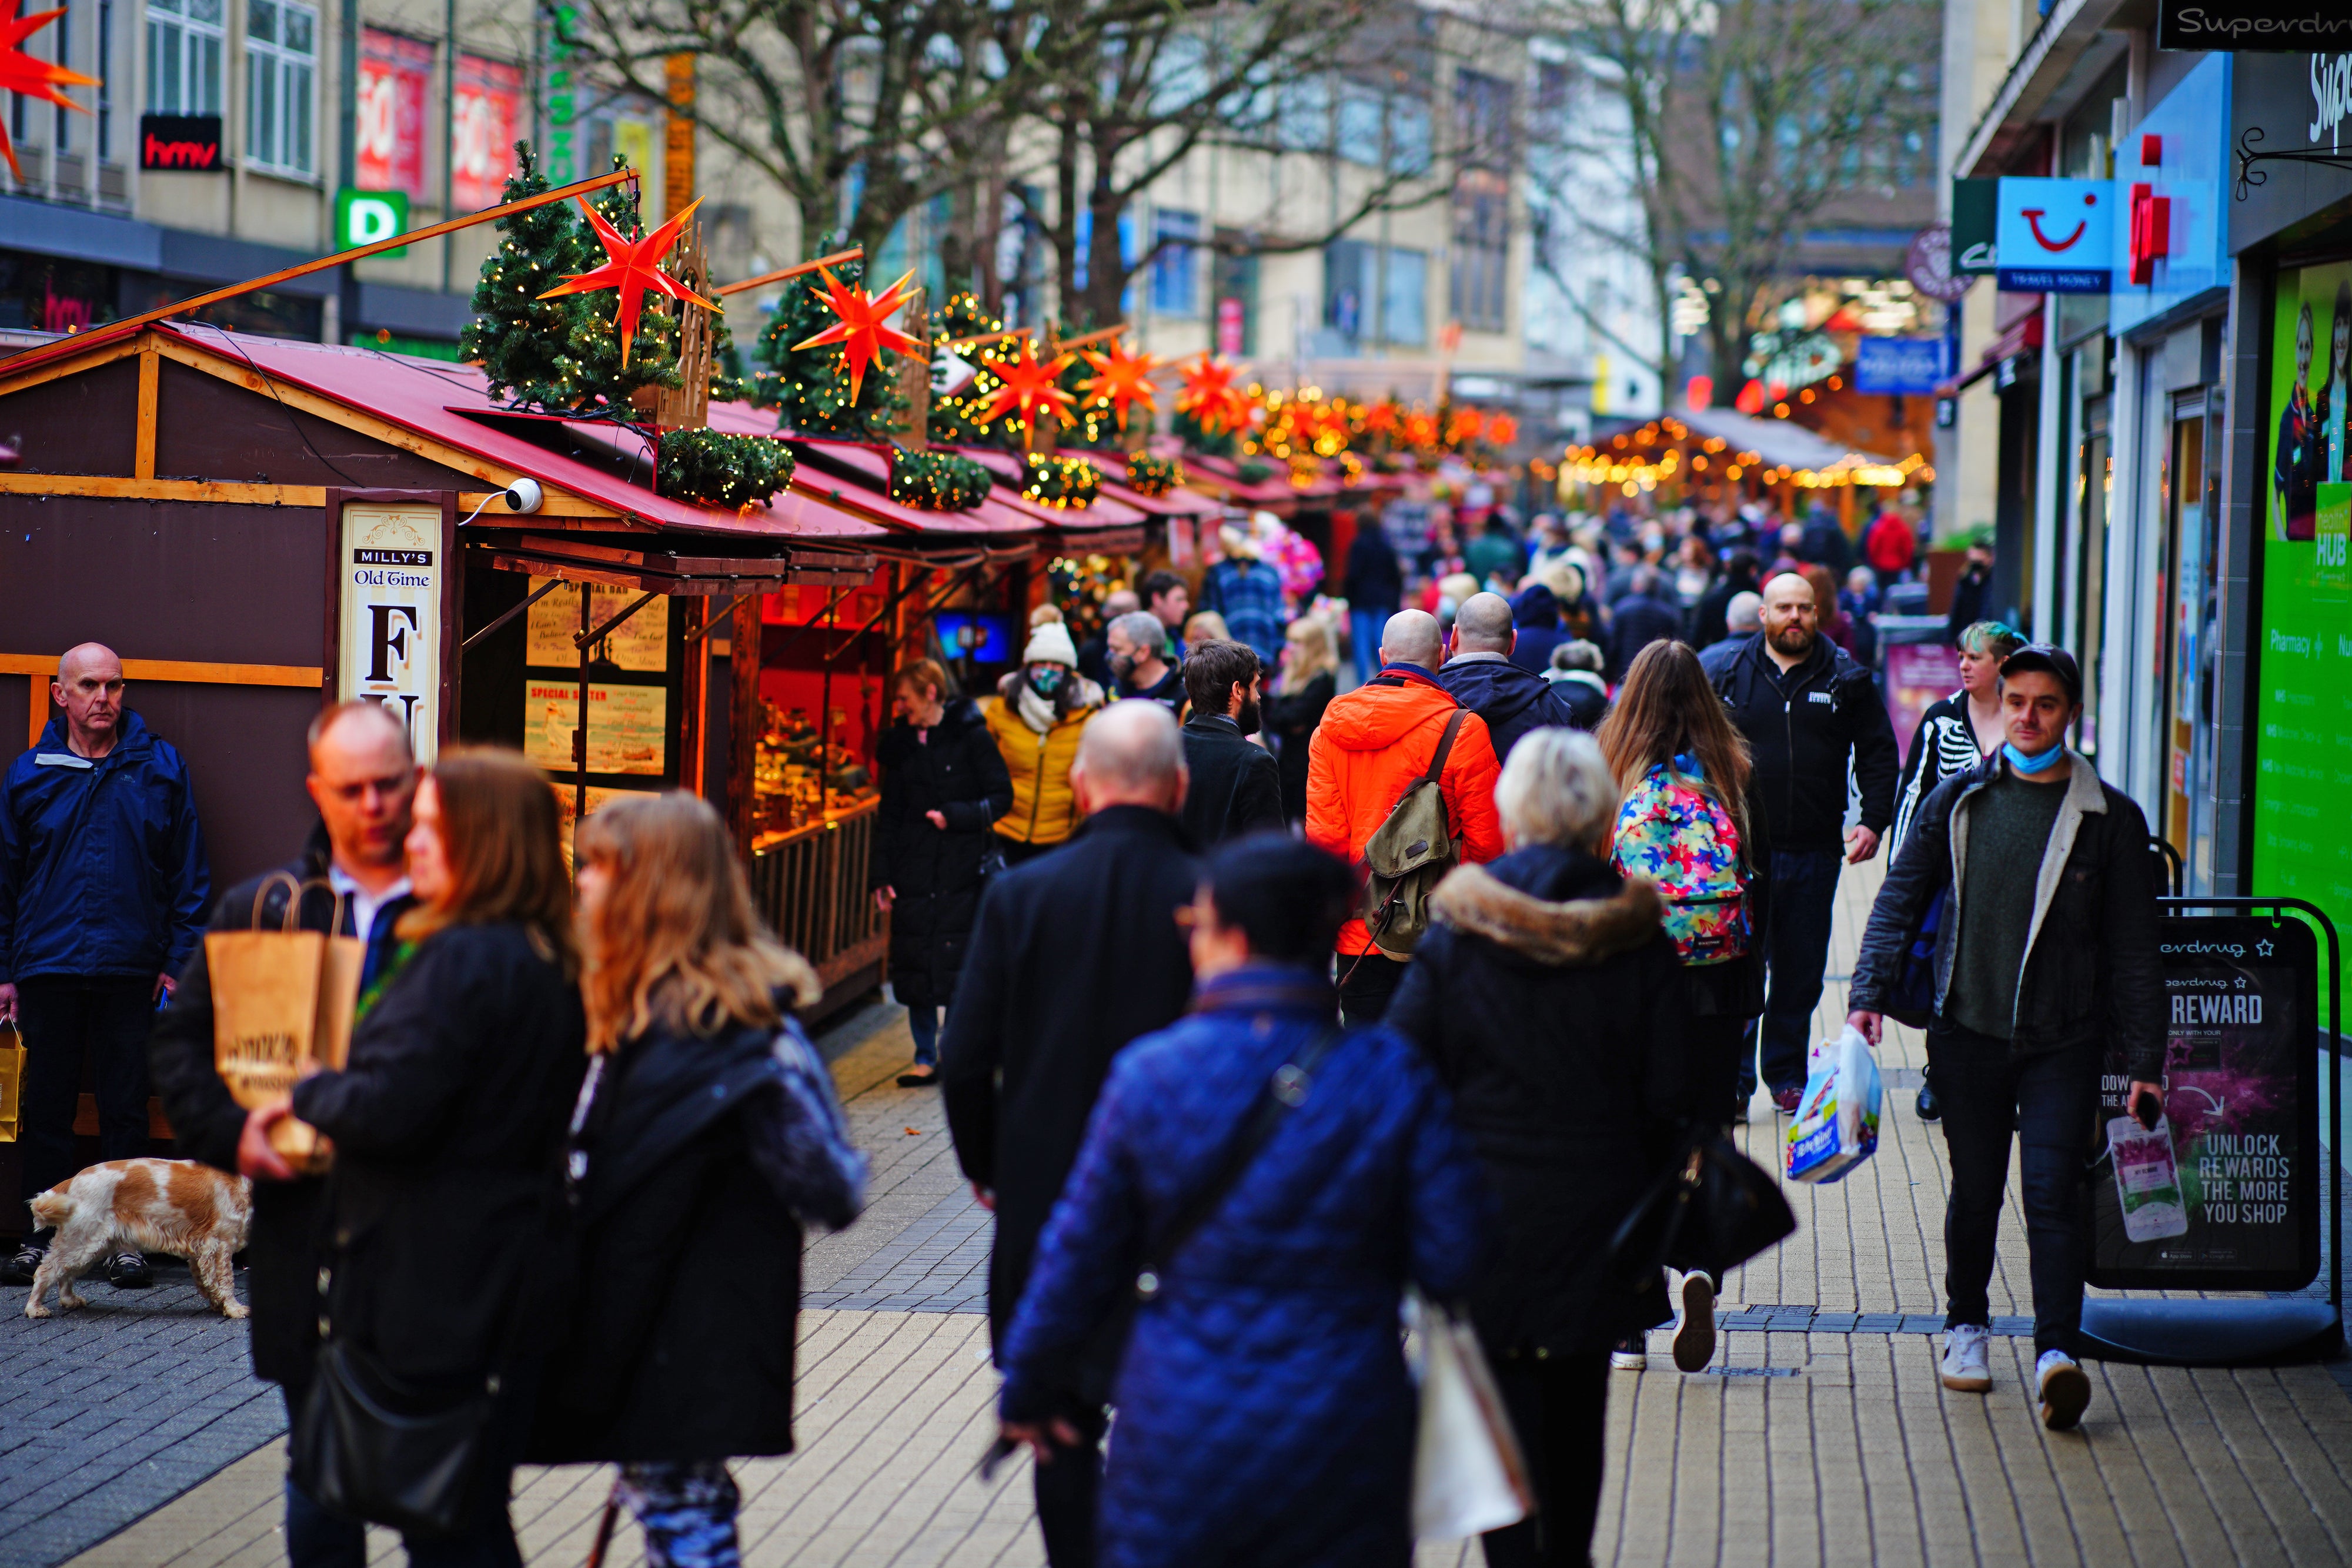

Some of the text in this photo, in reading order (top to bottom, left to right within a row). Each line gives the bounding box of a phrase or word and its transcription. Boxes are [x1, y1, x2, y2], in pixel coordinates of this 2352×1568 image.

[2178, 8, 2352, 39] Superdr
[145, 132, 217, 169] hmv
[361, 551, 427, 564] MILLY'S
[2316, 533, 2347, 567] HUB
[354, 570, 431, 587] Old Time
[2270, 628, 2311, 659] Pharmacy
[531, 687, 607, 702] SPECIAL STER
[2160, 940, 2247, 958] erdrug
[2165, 978, 2229, 989] erdrug
[2171, 995, 2263, 1024] REWARD
[2102, 1075, 2170, 1091] DOWD
[2102, 1095, 2118, 1107] THE
[2207, 1134, 2281, 1156] UNLOCK
[2199, 1157, 2290, 1179] REWARDS
[2201, 1181, 2289, 1202] THE MORE
[2204, 1203, 2287, 1224] YOU SHOP
